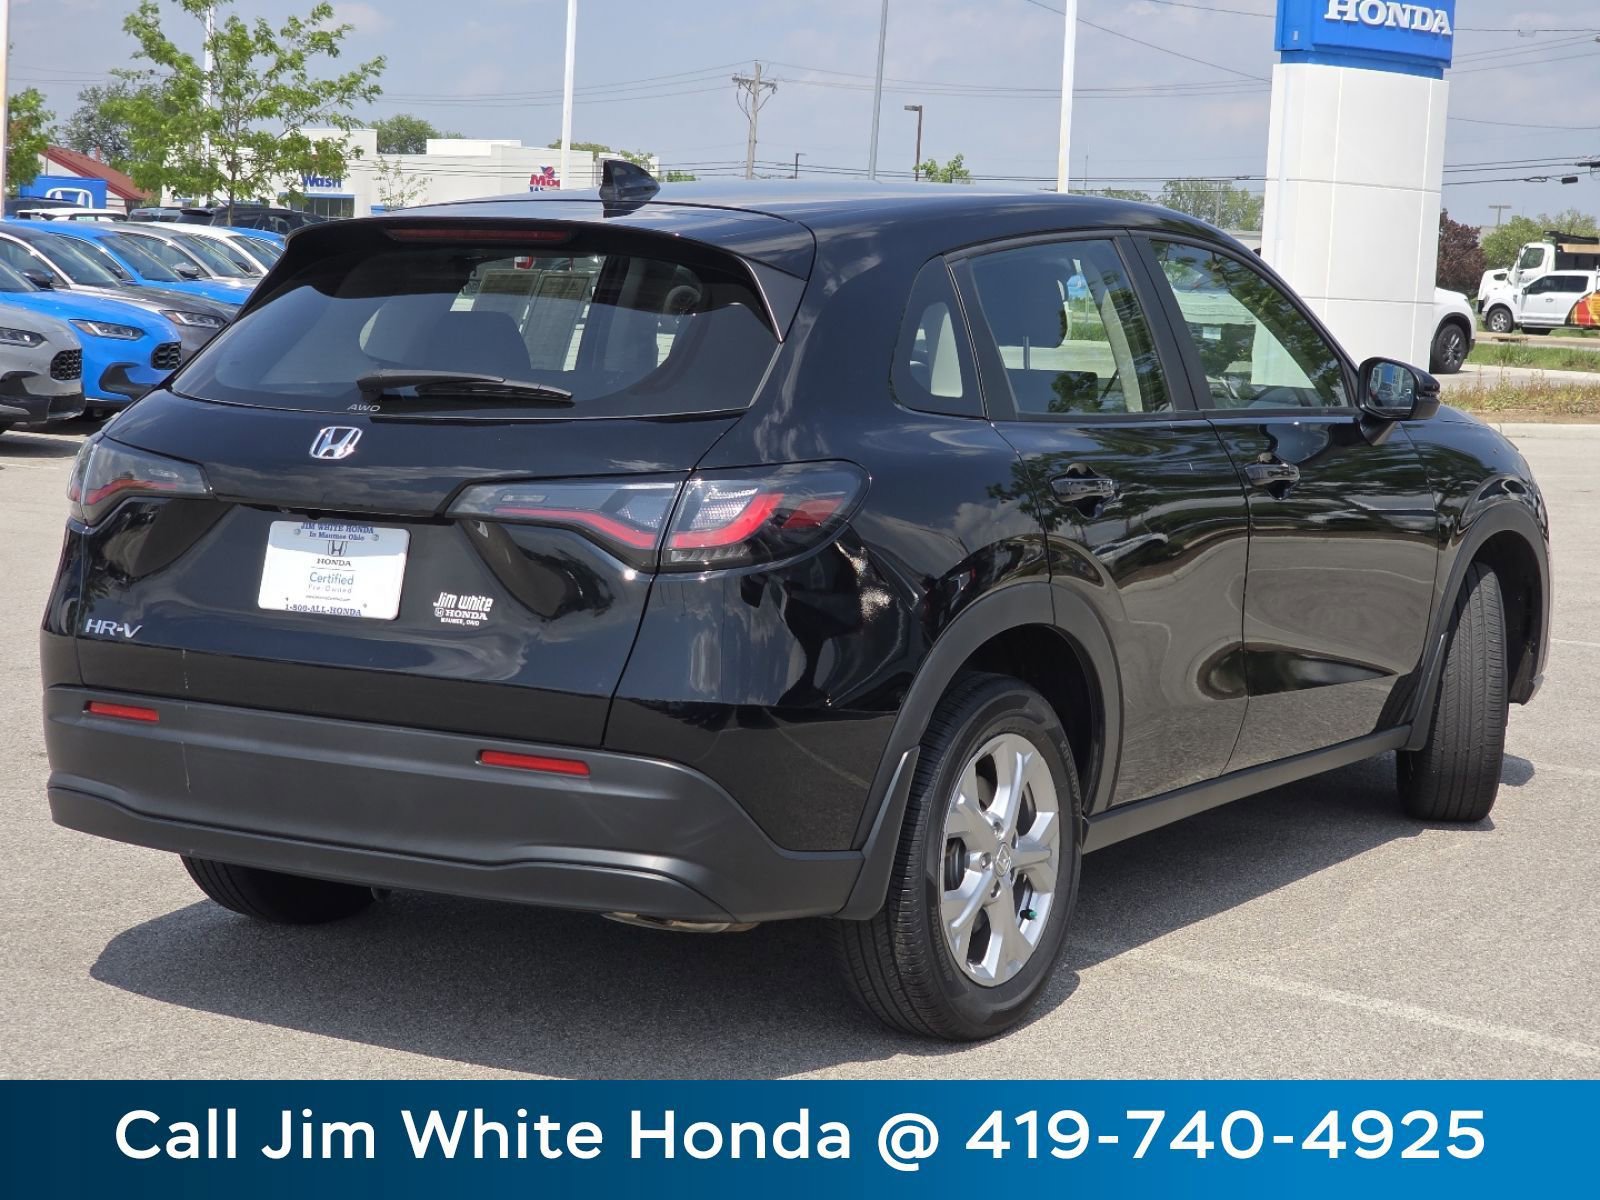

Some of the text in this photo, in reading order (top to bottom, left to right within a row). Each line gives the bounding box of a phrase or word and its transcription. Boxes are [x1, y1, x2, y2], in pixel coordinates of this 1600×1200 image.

[1324, 0, 1452, 35] HONDA
[347, 403, 381, 412] AWD
[301, 522, 374, 534] JIM WHITE HONDA
[316, 558, 352, 567] HONDA
[310, 571, 354, 585] Certified
[433, 592, 494, 612] Jim White
[285, 603, 361, 617] 1-800-ALL-HONDA
[445, 609, 488, 620] HONDA
[85, 618, 143, 638] HR-V
